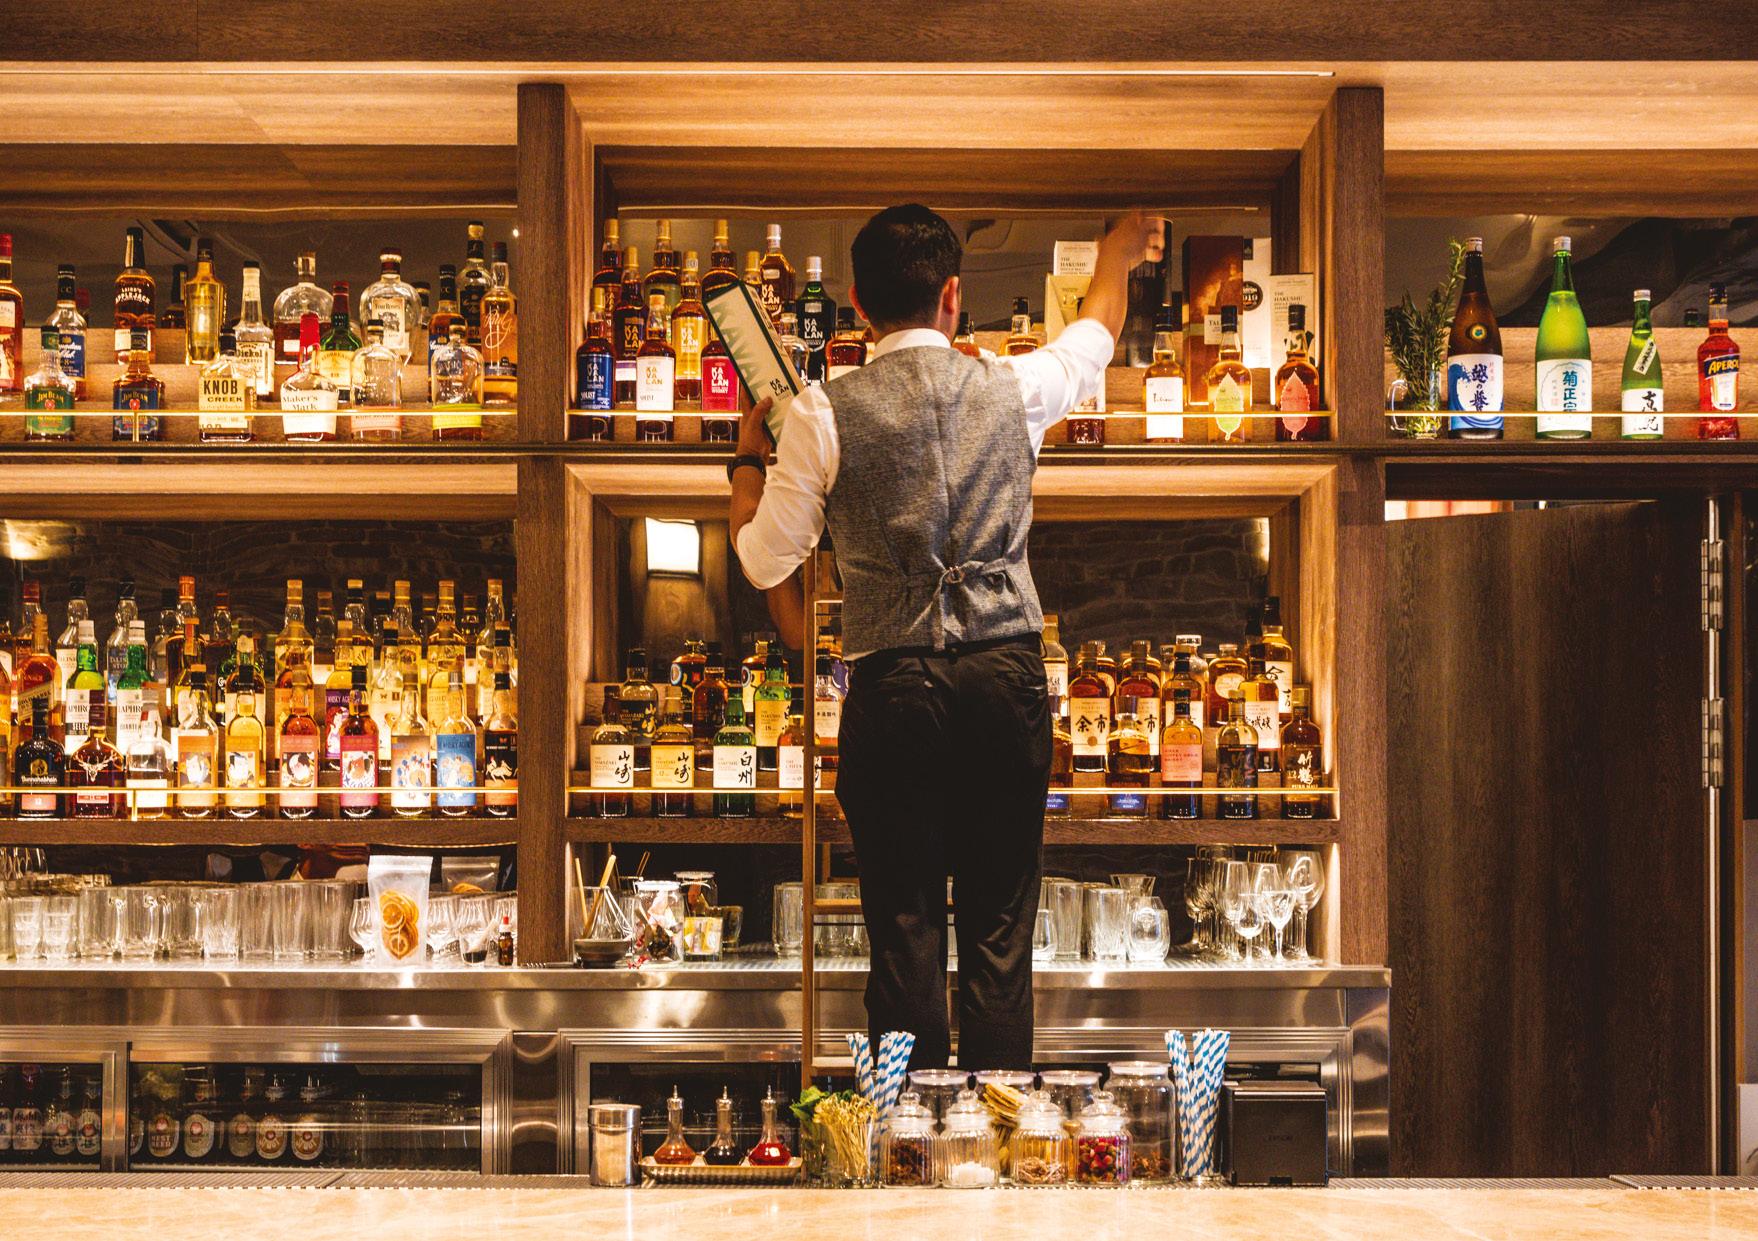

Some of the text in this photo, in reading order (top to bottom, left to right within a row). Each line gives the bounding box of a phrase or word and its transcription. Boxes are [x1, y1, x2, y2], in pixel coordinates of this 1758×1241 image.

[762, 284, 775, 292] KA
[115, 291, 151, 304] APPLEJACK
[762, 290, 774, 298] VA
[625, 333, 639, 341] VA
[805, 331, 823, 339] LAN
[625, 340, 644, 348] LAN
[204, 380, 238, 394] KNOB
[711, 379, 729, 387] LAN
[775, 385, 789, 396] LAN
[72, 722, 88, 730] SELEC
[1075, 714, 1107, 733] 余市
[615, 750, 632, 784] 山崎
[674, 751, 690, 784] 山崎
[738, 751, 752, 786] 白州
[21, 775, 57, 783] Bunnahabhain
